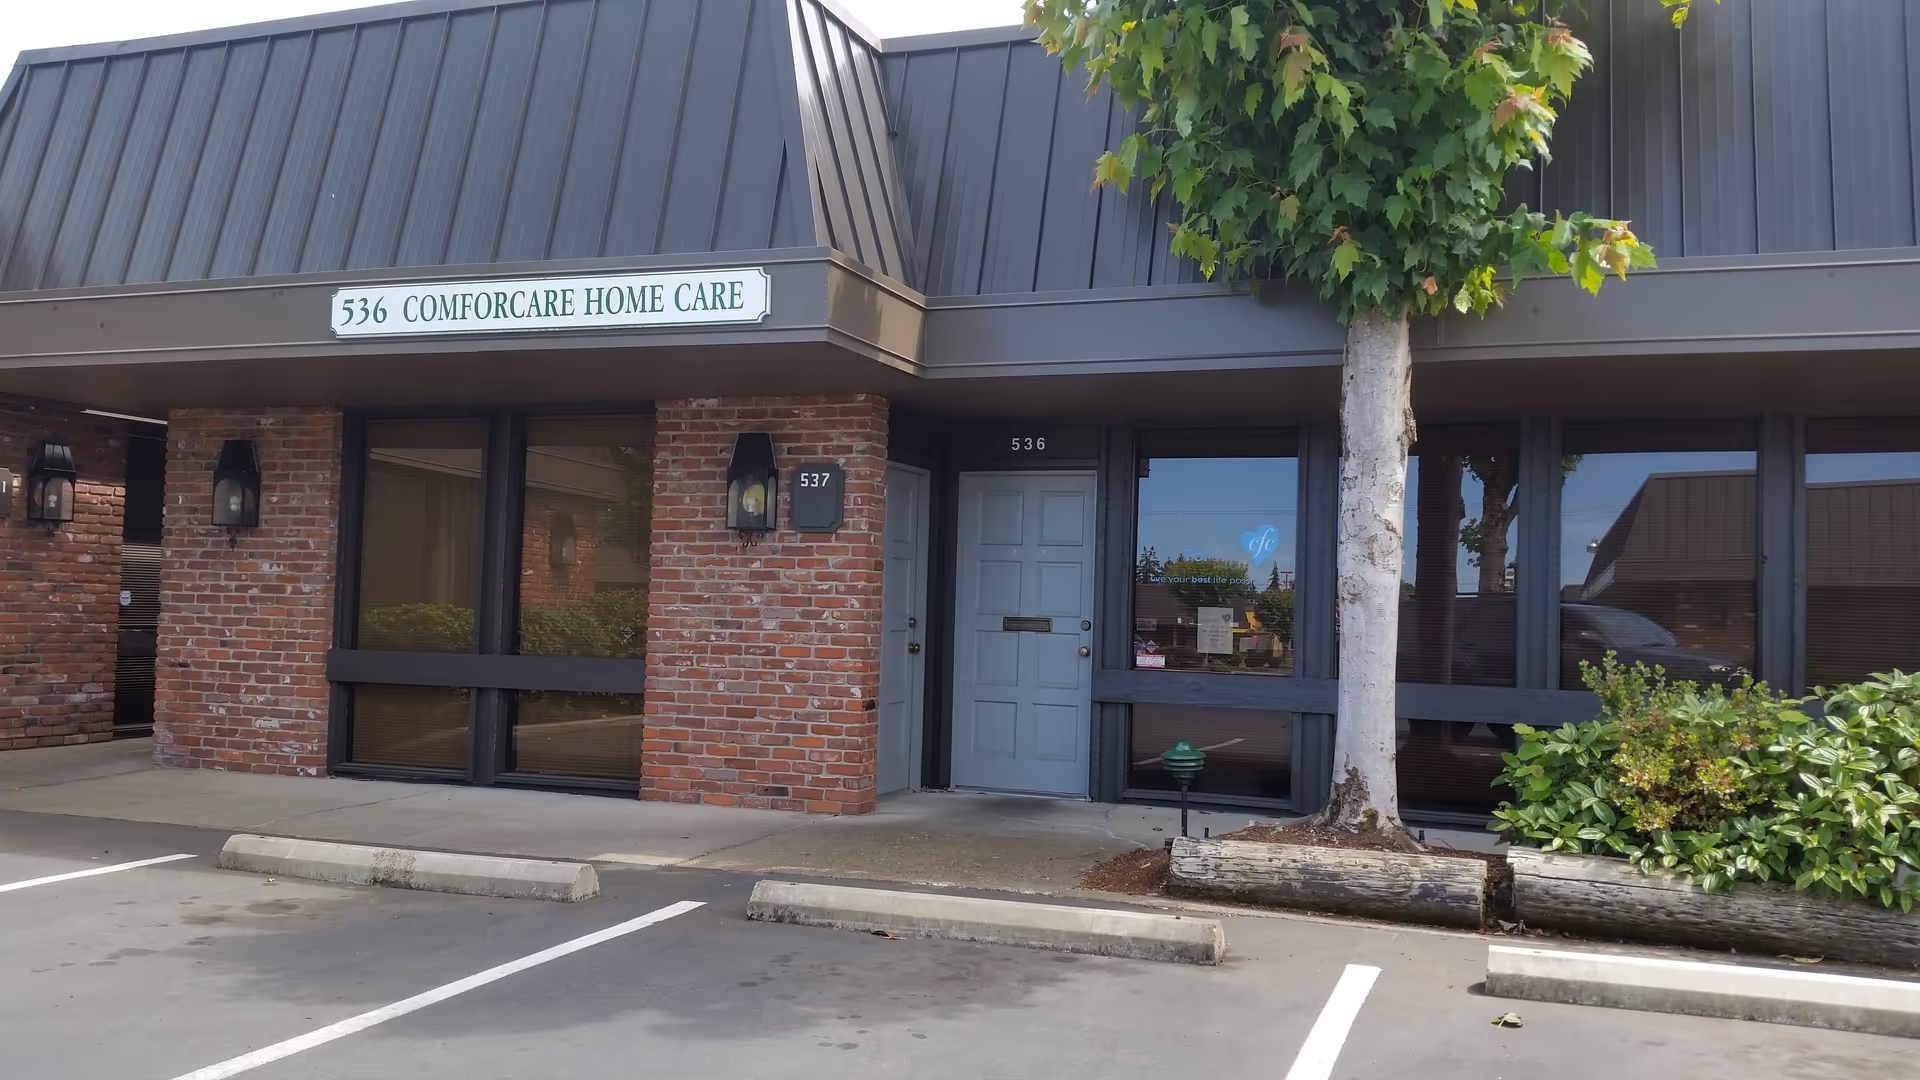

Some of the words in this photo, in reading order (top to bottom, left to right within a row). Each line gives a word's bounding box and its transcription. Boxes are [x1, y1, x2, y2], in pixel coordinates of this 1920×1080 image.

[340, 295, 388, 326] 536
[403, 287, 575, 323] COMFORCARE
[584, 284, 665, 316] HOME
[674, 280, 745, 310] CARE
[1011, 437, 1047, 451] 536
[800, 472, 831, 488] 537
[1249, 527, 1275, 559] cfc
[1168, 576, 1189, 584] your
[1191, 575, 1210, 584] best
